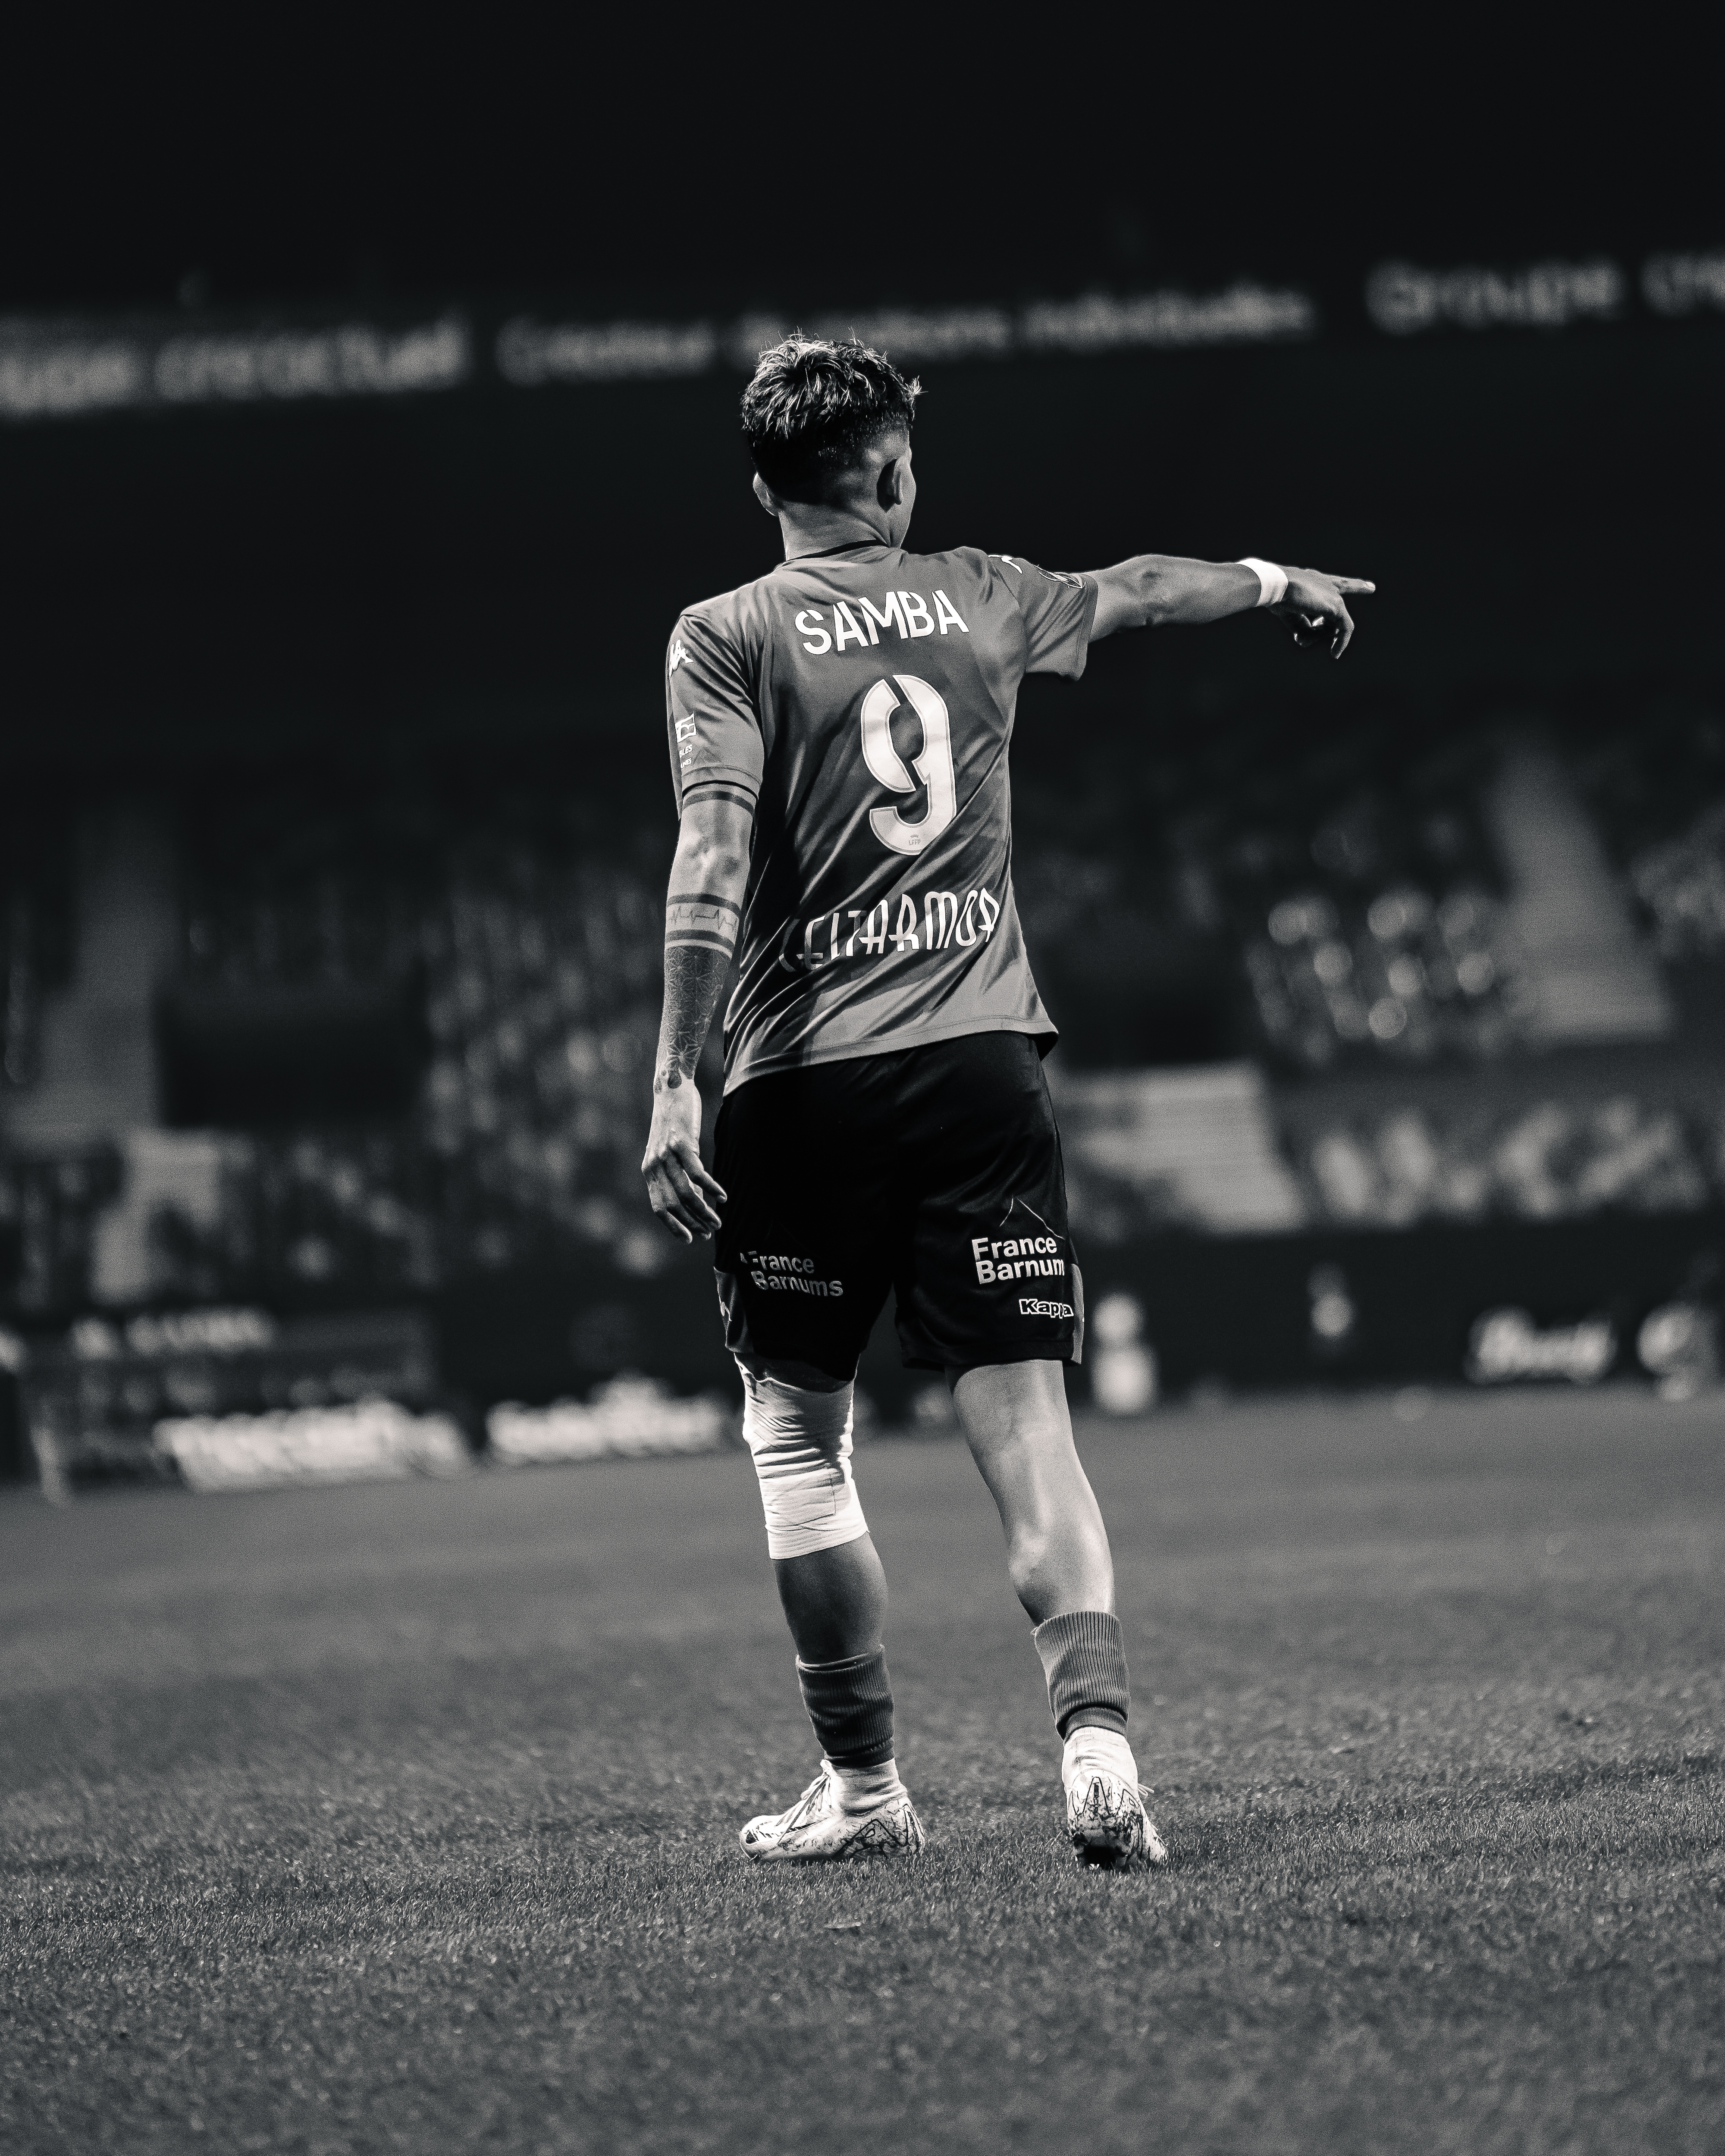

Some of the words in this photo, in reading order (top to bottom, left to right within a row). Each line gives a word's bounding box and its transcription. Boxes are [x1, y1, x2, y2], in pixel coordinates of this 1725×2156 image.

[795, 589, 970, 655] SAMBA
[861, 674, 957, 856] 9
[740, 1250, 815, 1273] France
[972, 1237, 1057, 1262] France
[751, 1271, 844, 1297] Barnums
[1019, 1298, 1074, 1319] Kappa
